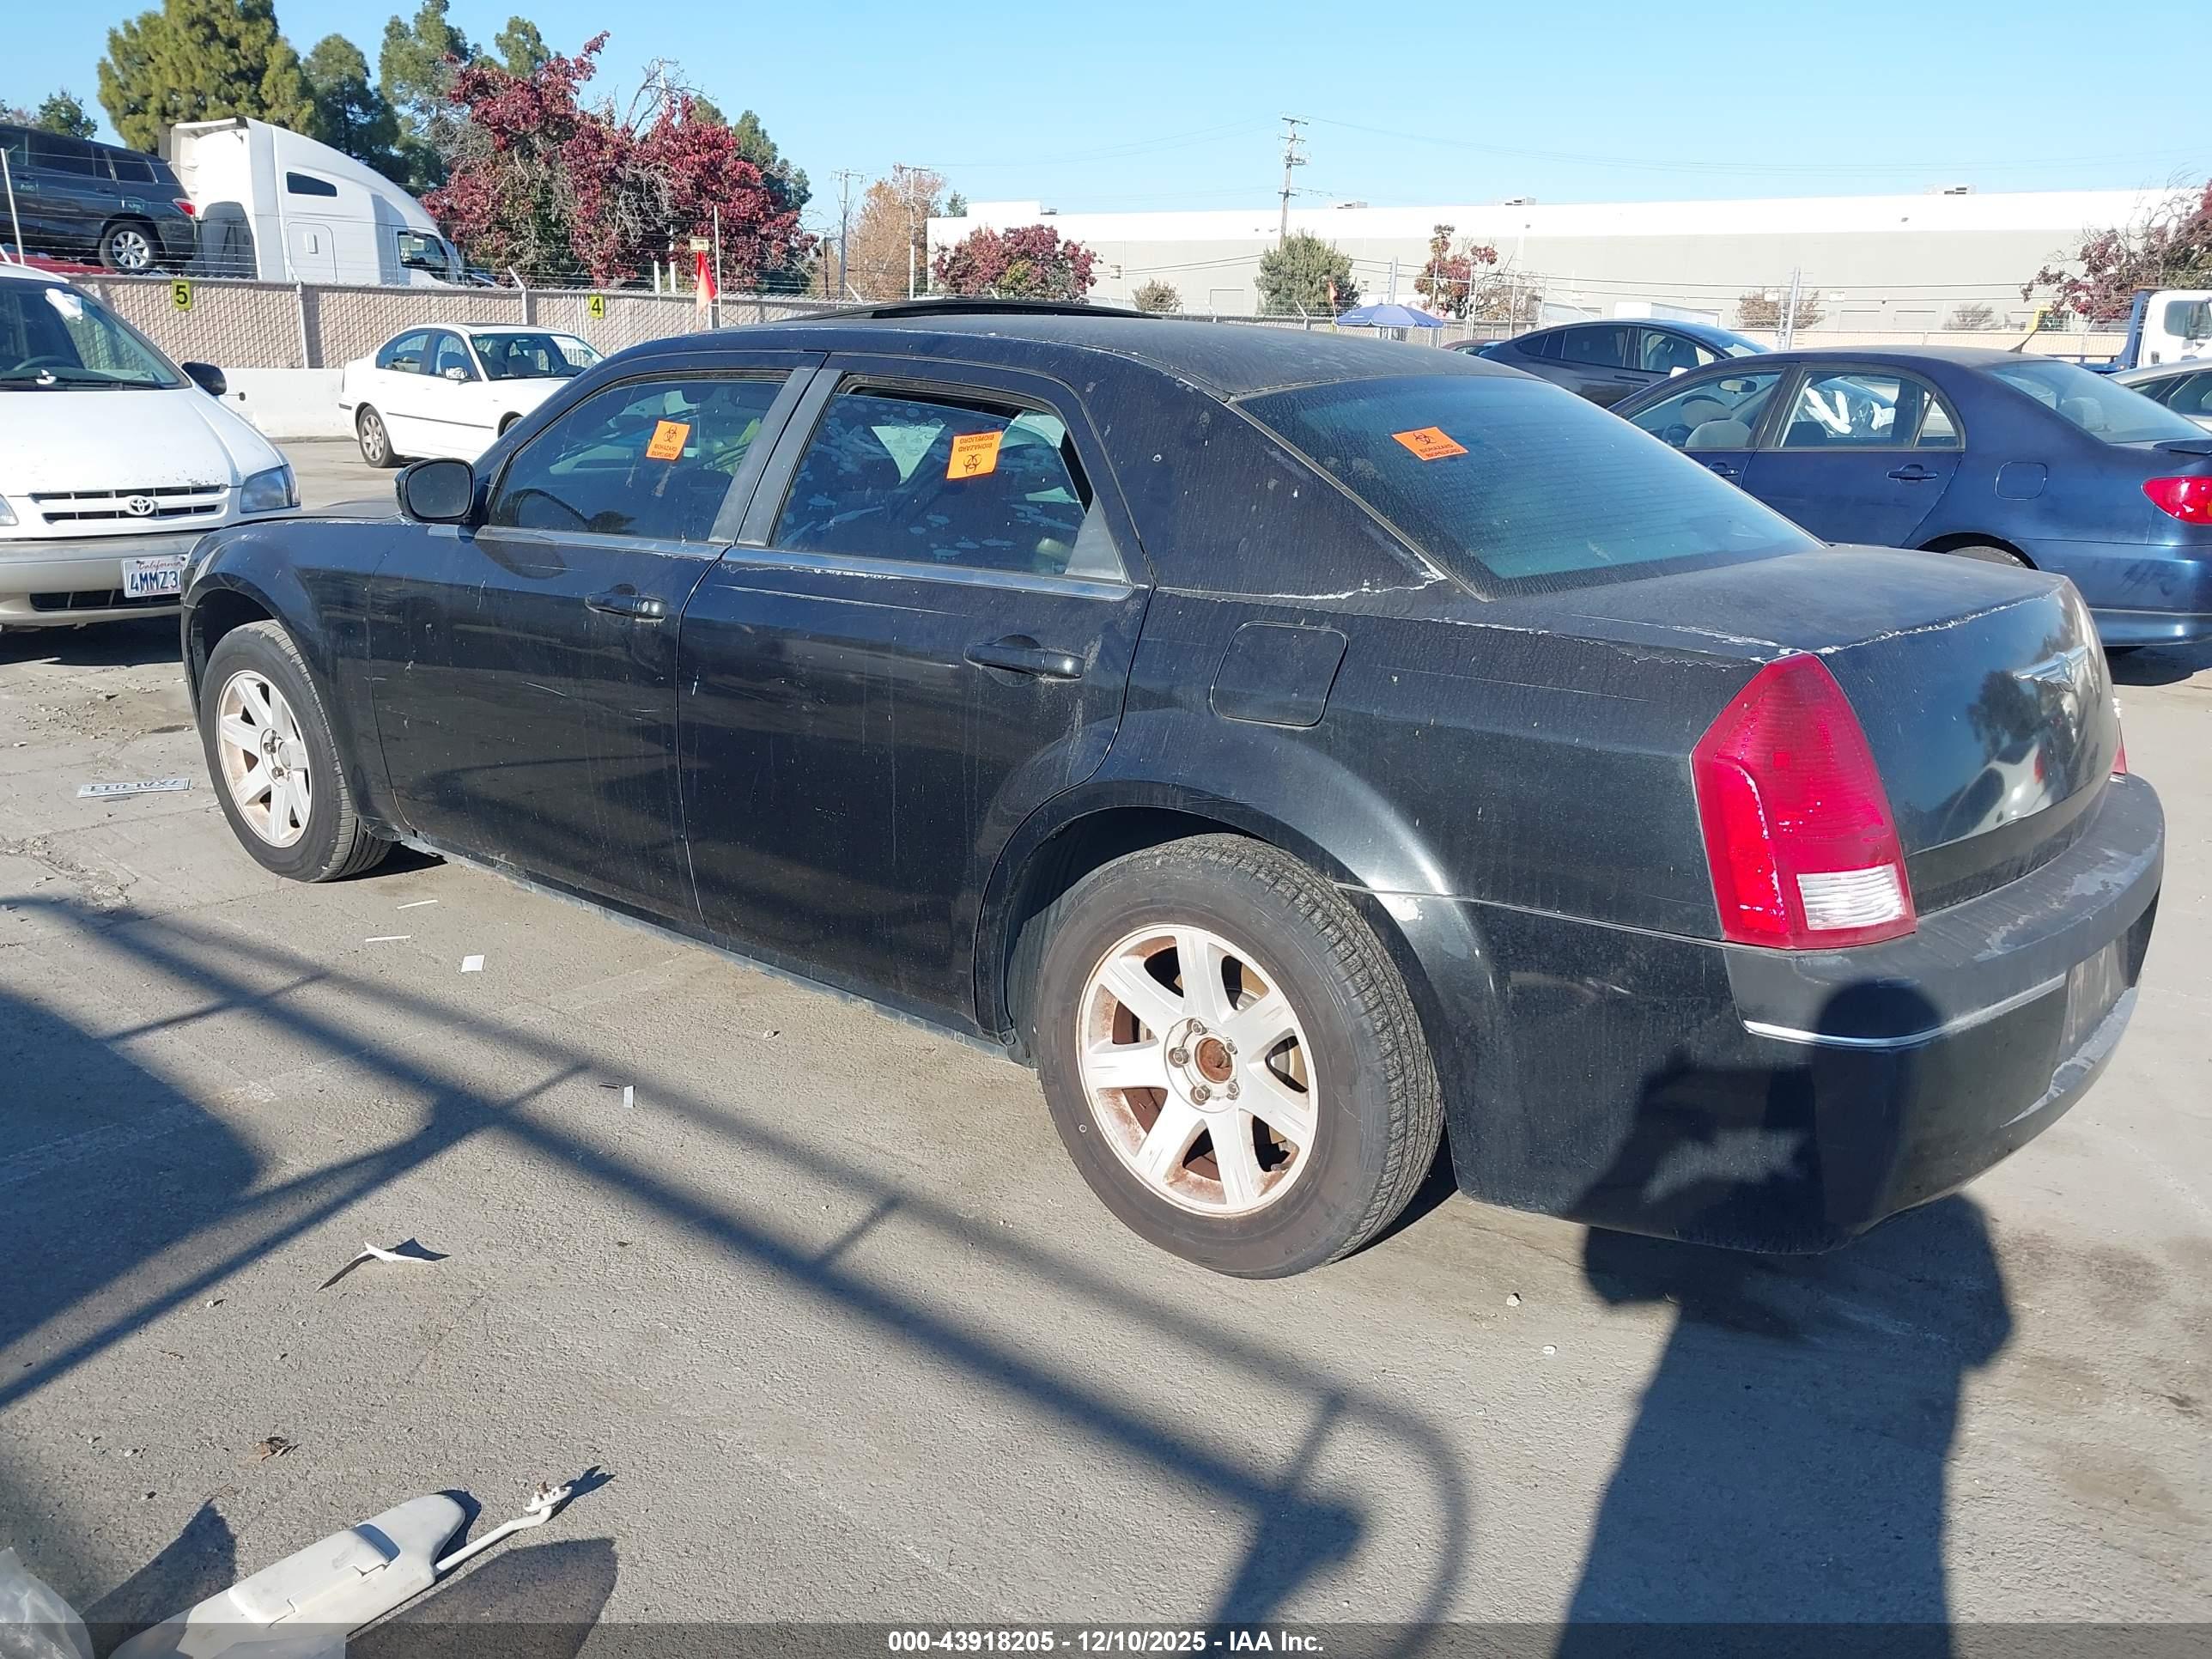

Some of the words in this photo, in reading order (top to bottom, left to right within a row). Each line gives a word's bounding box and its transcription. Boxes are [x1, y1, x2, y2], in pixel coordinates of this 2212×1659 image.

[176, 284, 188, 304] 5
[592, 297, 602, 314] 4
[957, 442, 993, 453] BIOHAZARD
[138, 560, 183, 570] California
[130, 570, 182, 592] 4MMZ3
